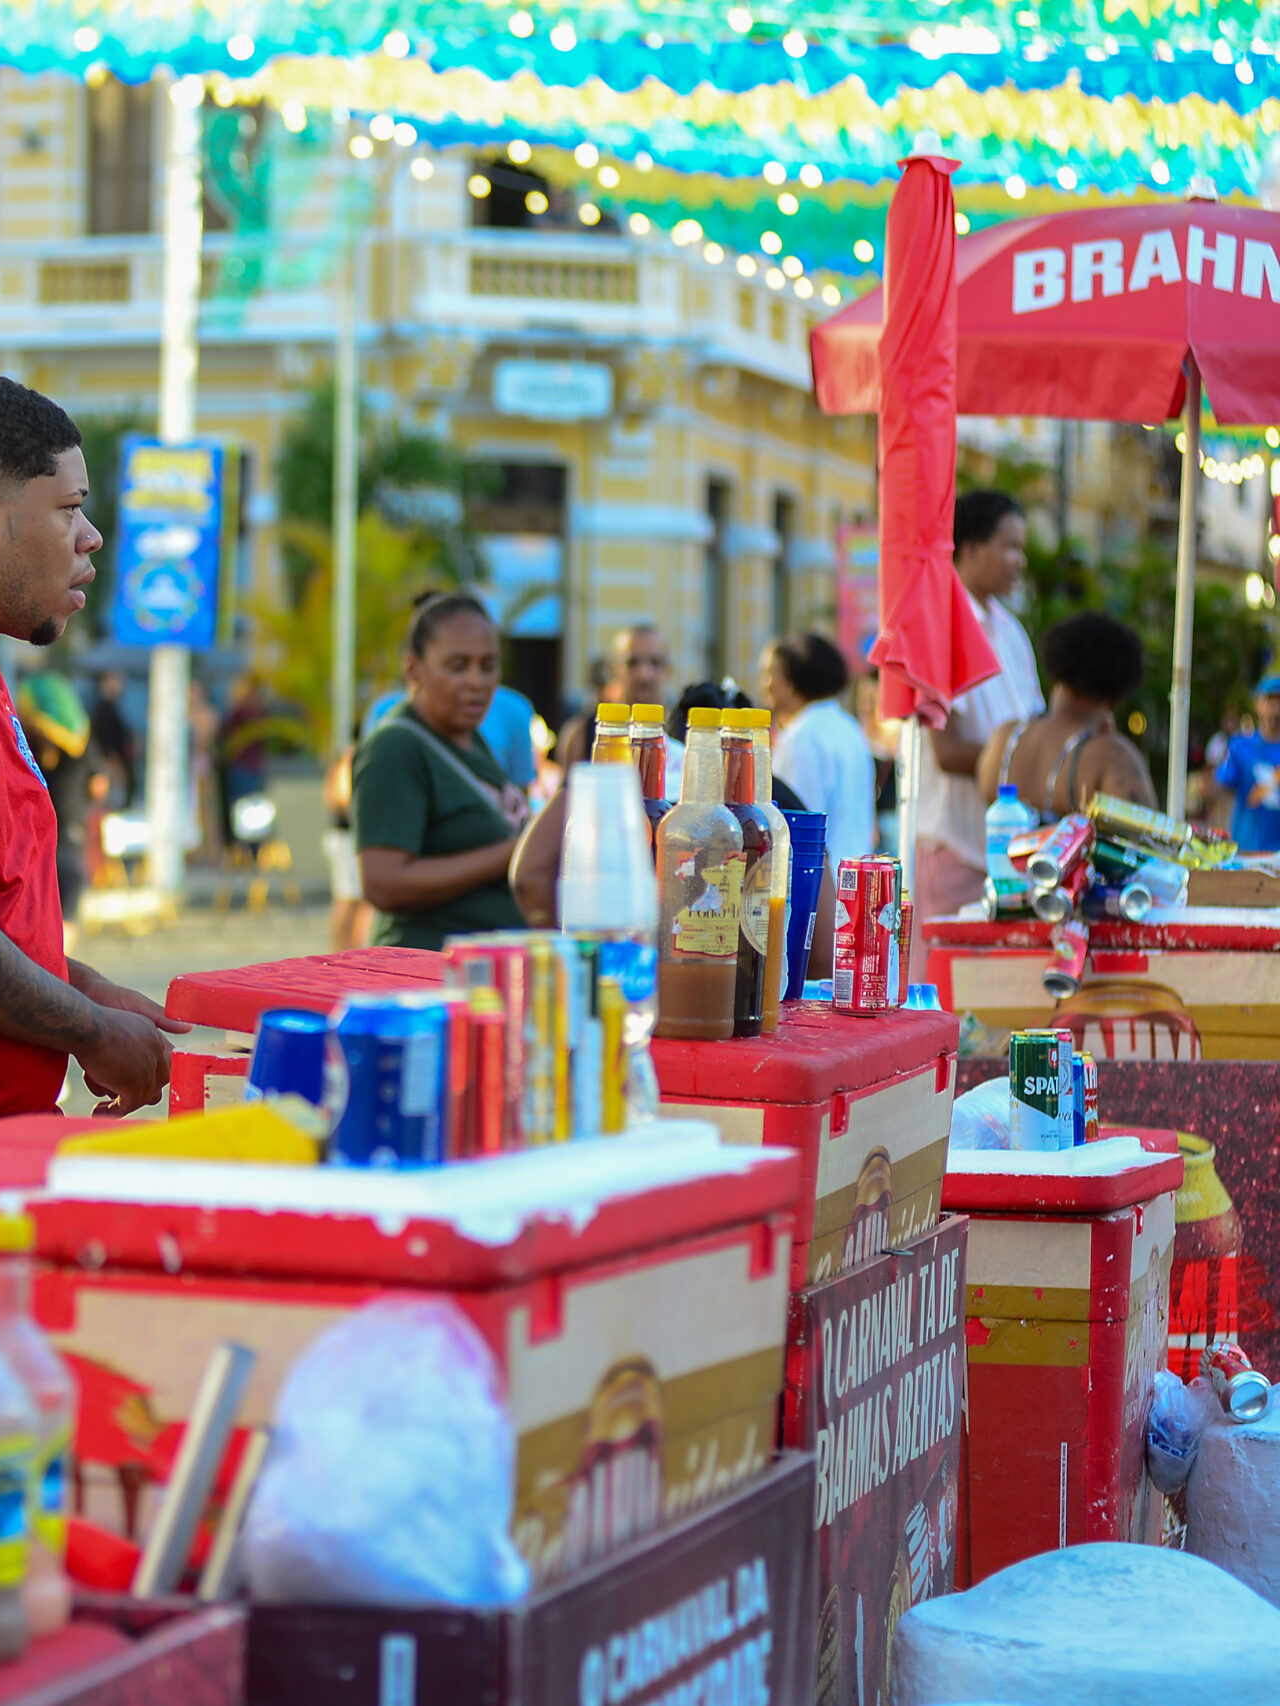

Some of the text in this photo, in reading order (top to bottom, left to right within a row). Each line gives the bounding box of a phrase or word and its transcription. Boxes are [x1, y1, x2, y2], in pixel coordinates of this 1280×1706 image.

[836, 1272, 914, 1399] CARNAVAL
[919, 1236, 938, 1347] TÁ
[938, 1248, 959, 1335] DE
[892, 1342, 957, 1476] ABERTAS
